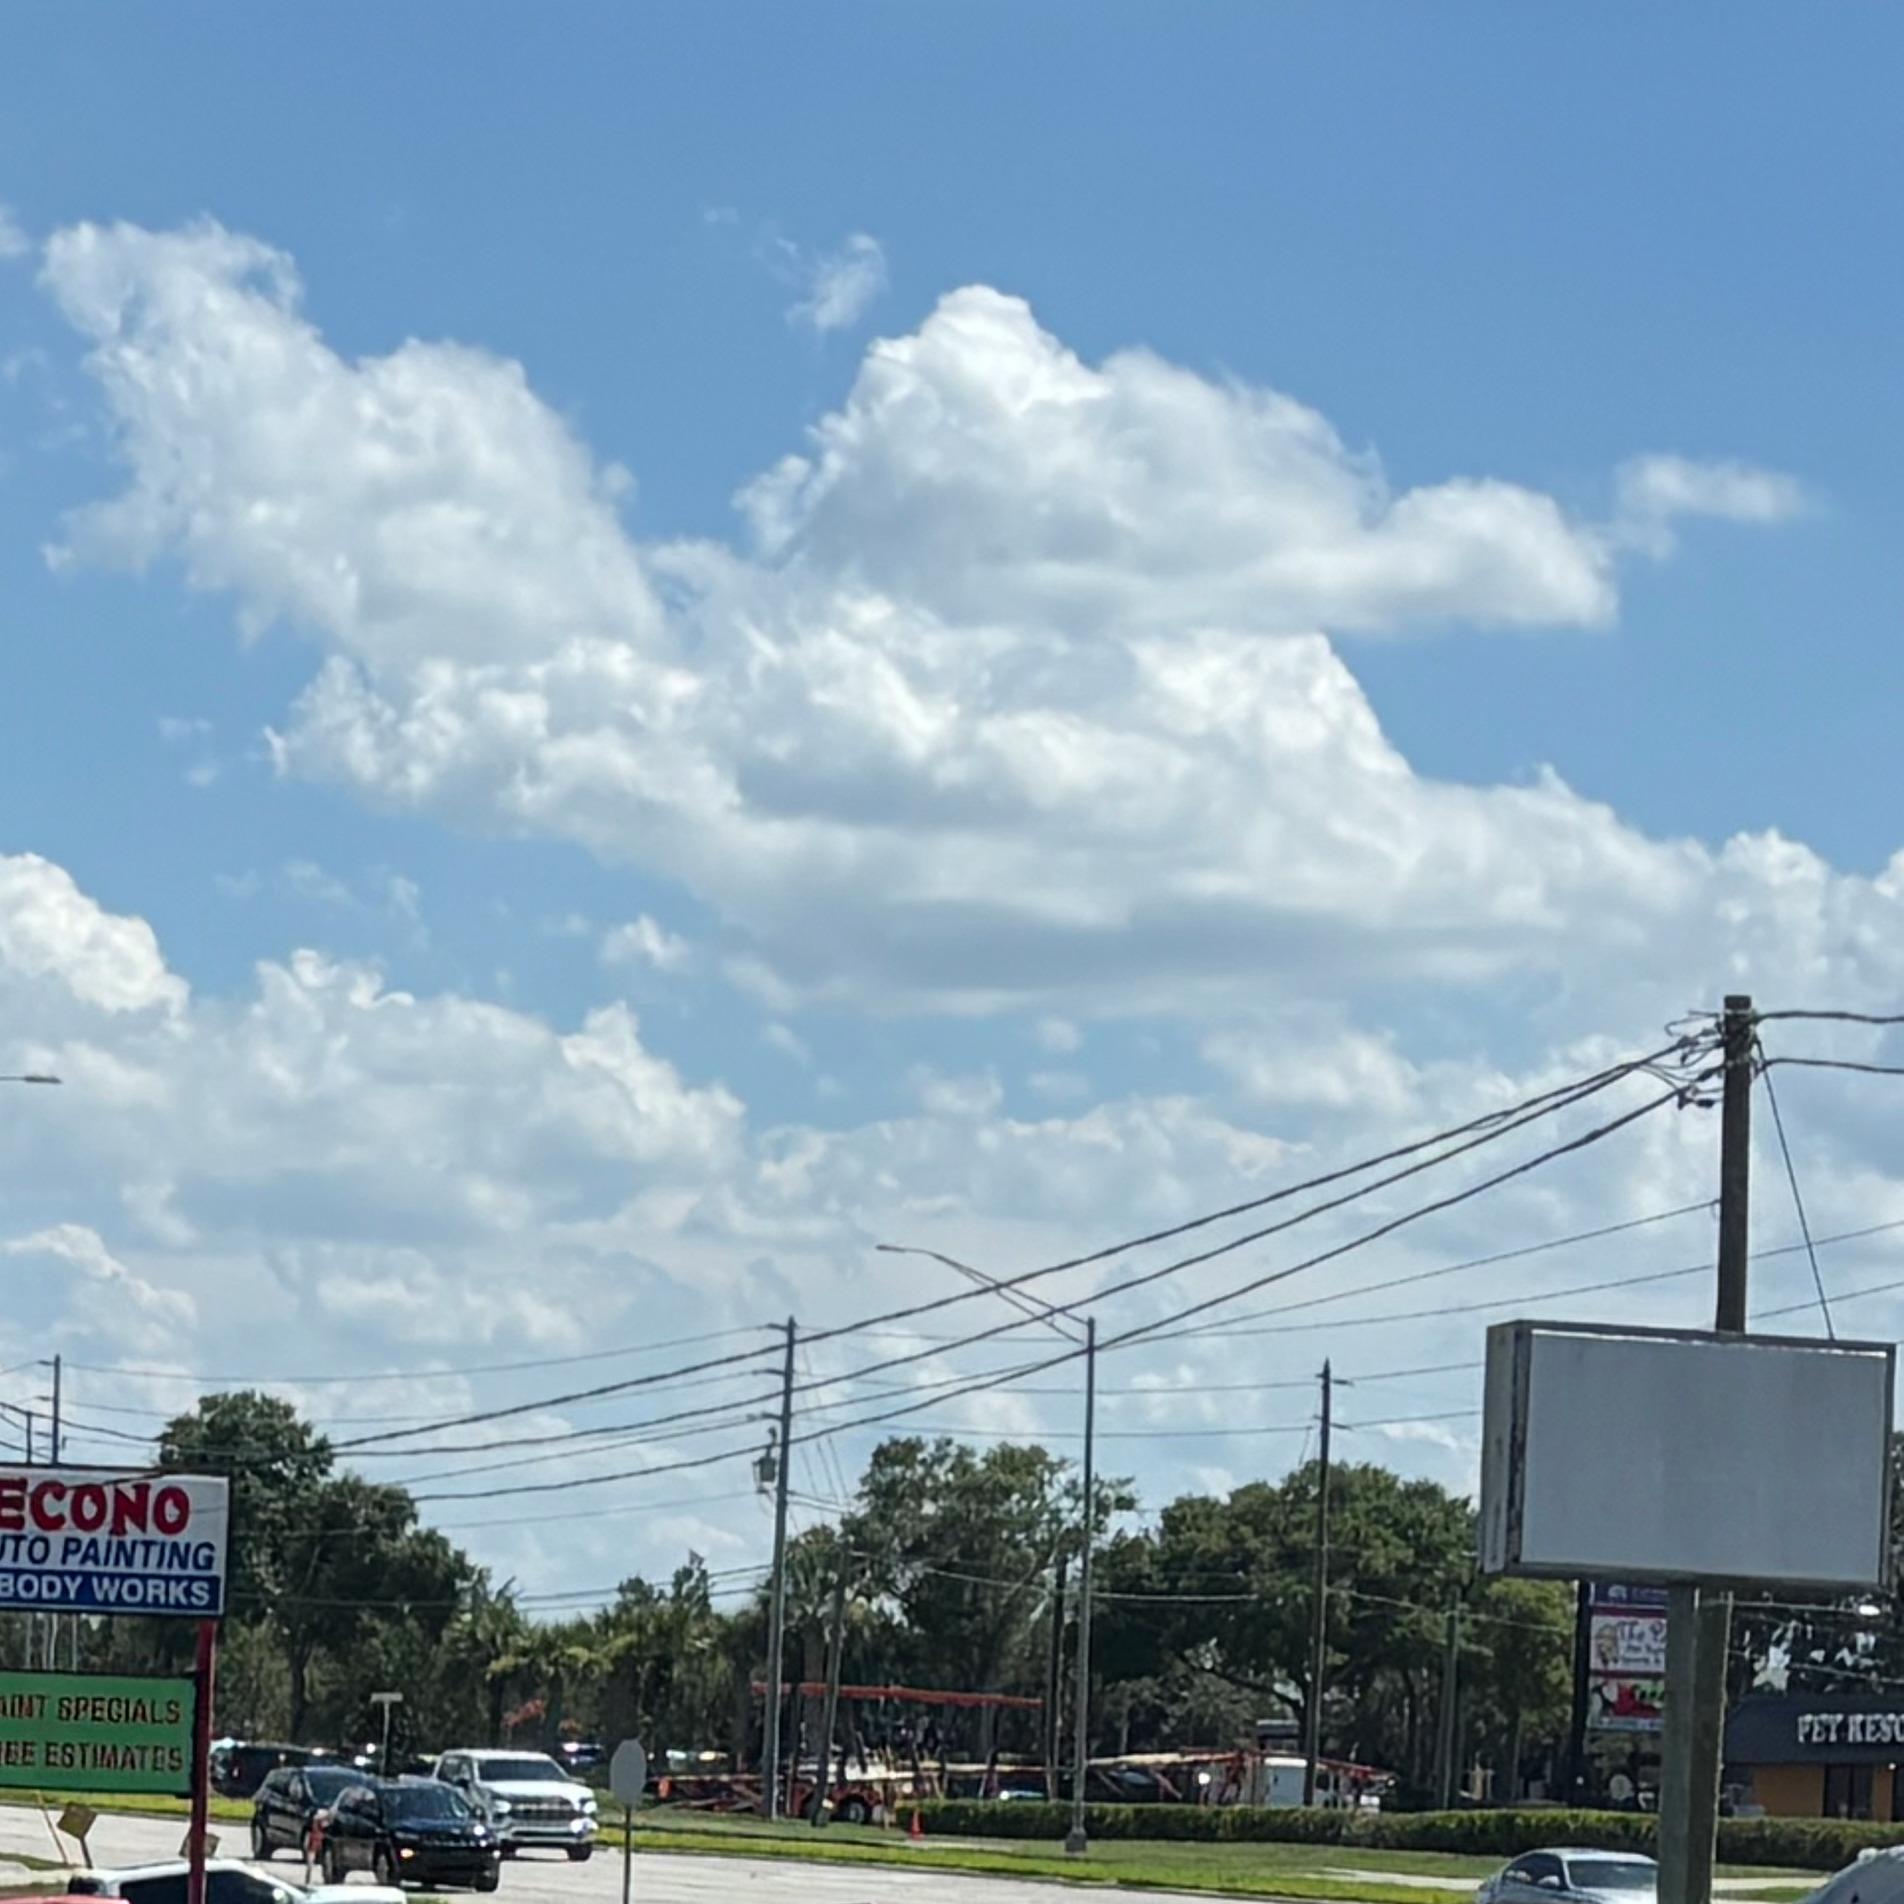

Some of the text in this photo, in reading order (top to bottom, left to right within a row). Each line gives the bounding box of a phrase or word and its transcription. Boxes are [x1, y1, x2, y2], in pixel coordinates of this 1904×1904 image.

[61, 1536, 216, 1571] PAINTING
[93, 1576, 210, 1606] WORKS
[58, 1696, 181, 1725] SPECIALS
[45, 1742, 183, 1772] ESTIMATES
